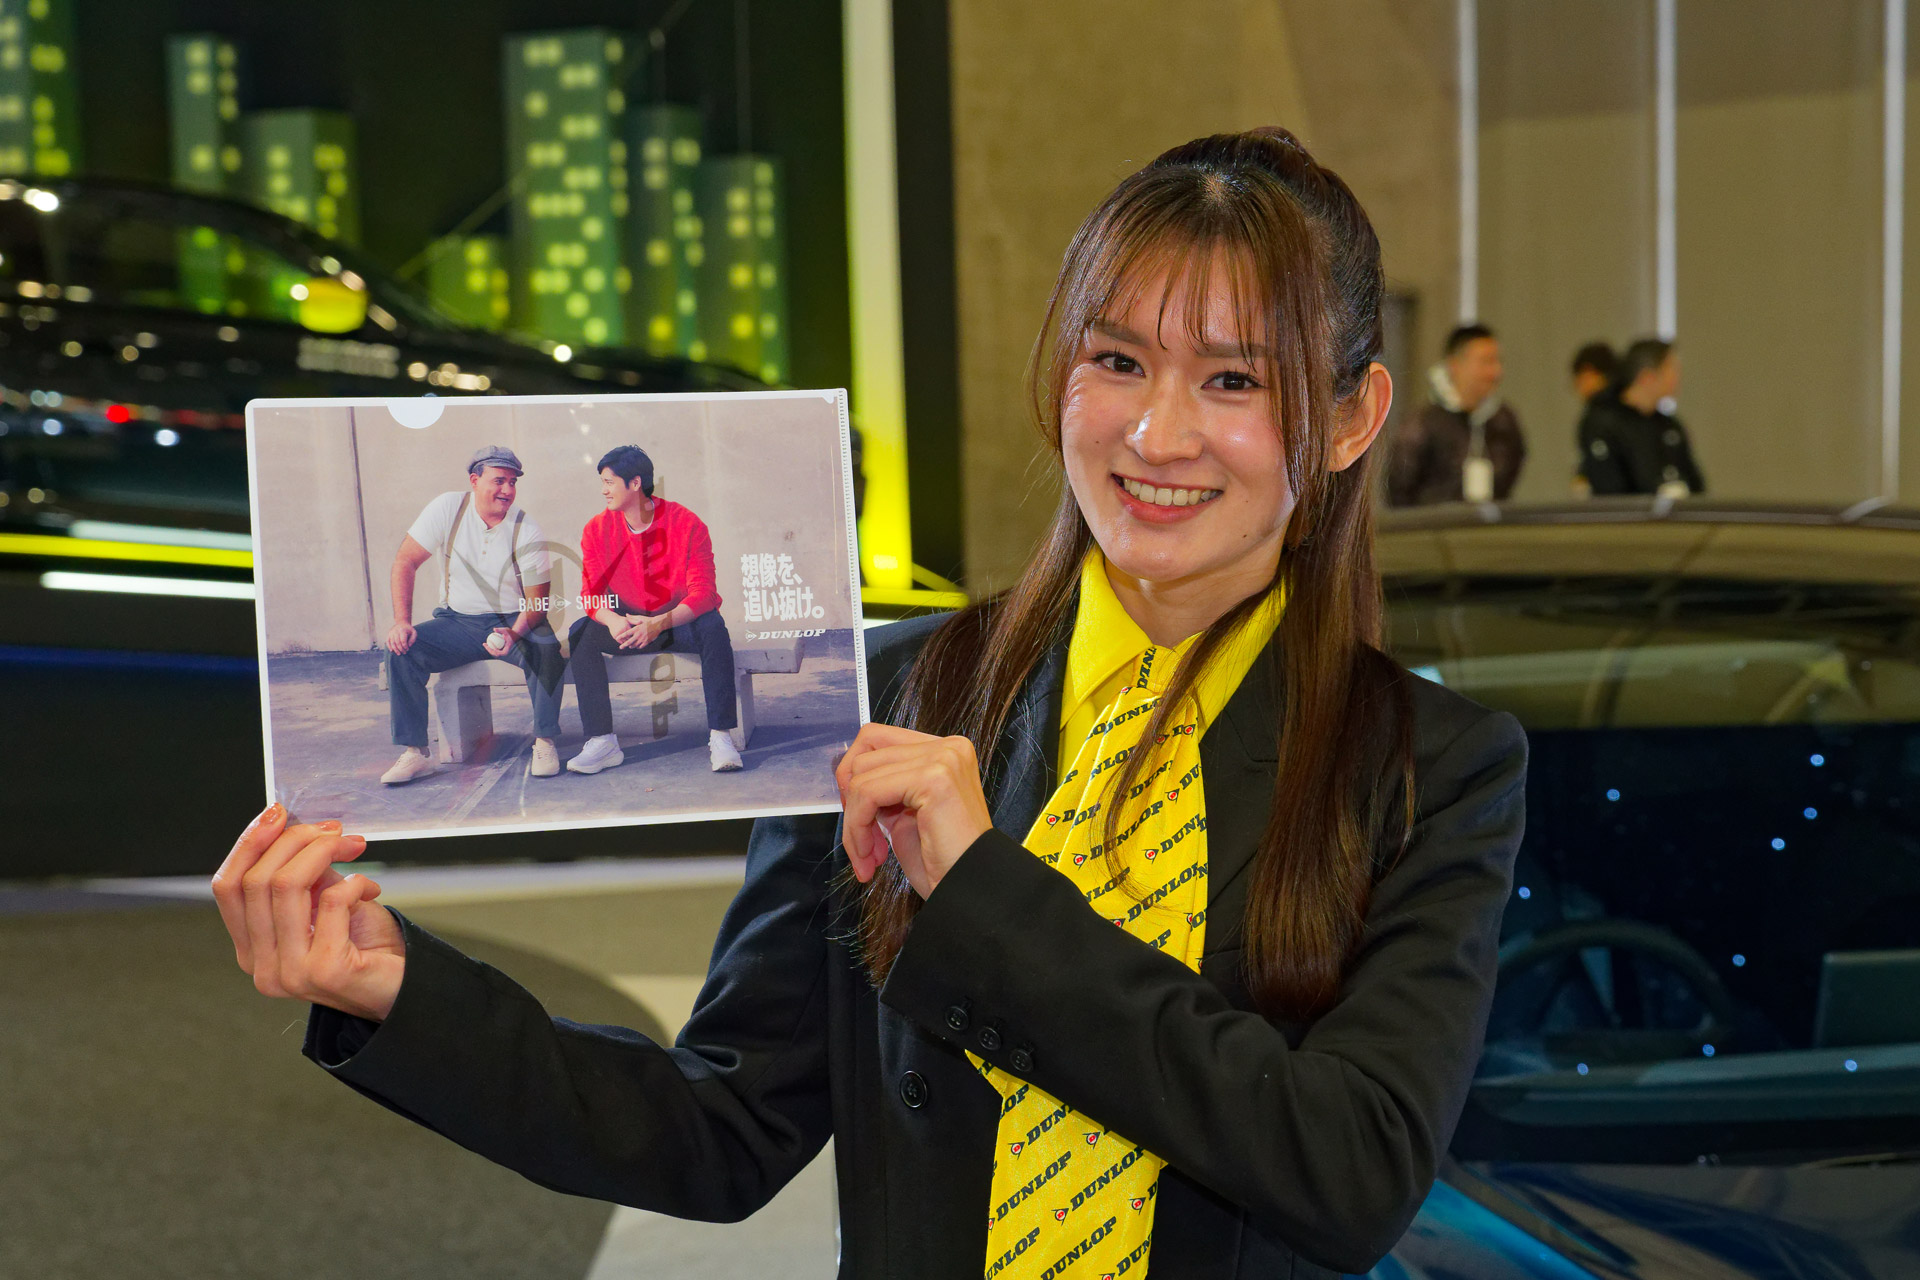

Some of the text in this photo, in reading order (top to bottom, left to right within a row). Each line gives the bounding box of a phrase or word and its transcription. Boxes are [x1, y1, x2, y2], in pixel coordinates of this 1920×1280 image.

[740, 553, 803, 588] 想像を、
[518, 594, 620, 612] BABE SHOHEI
[743, 586, 825, 622] 追い抜け。
[758, 628, 826, 640] DUNLOP
[995, 1150, 1072, 1222] DUNLOP
[1040, 1216, 1117, 1280] DUNLOP
